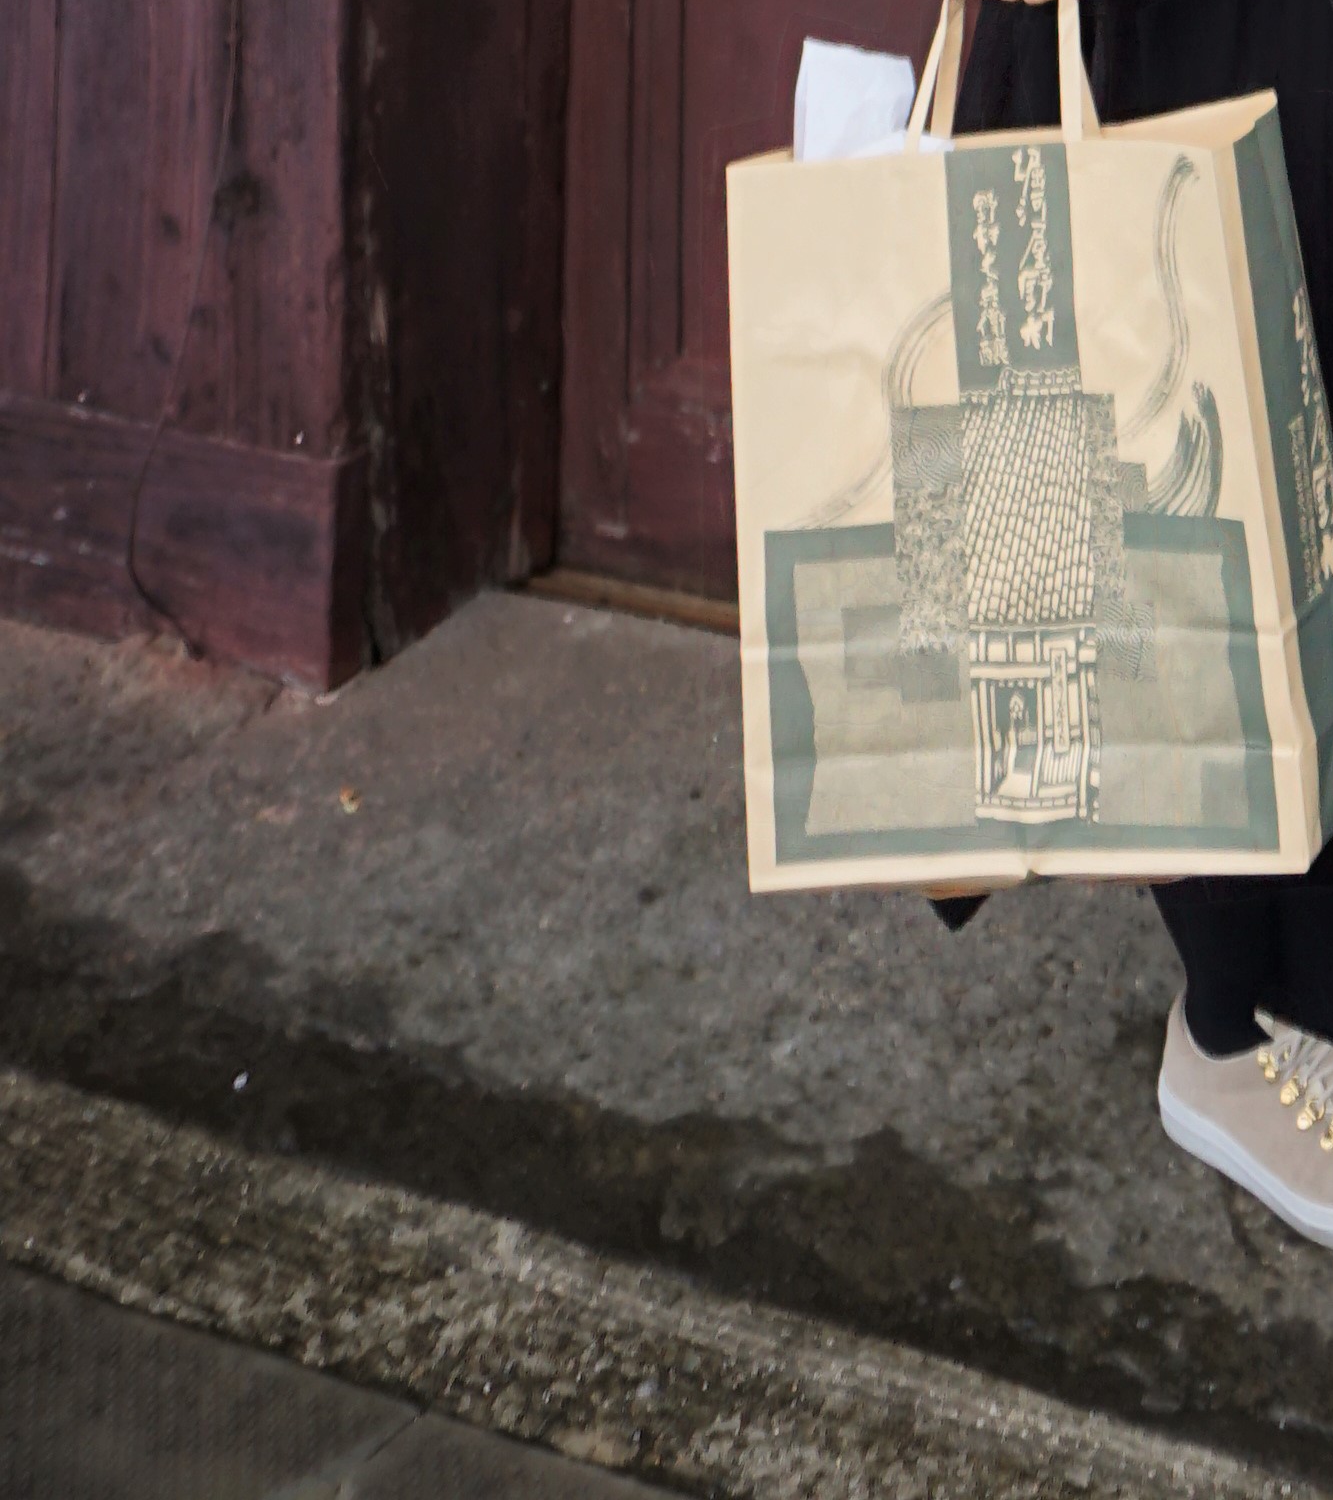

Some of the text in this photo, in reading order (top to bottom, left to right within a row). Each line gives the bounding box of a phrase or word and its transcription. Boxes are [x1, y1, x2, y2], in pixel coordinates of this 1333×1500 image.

[1011, 146, 1055, 351] 堀河屋野村
